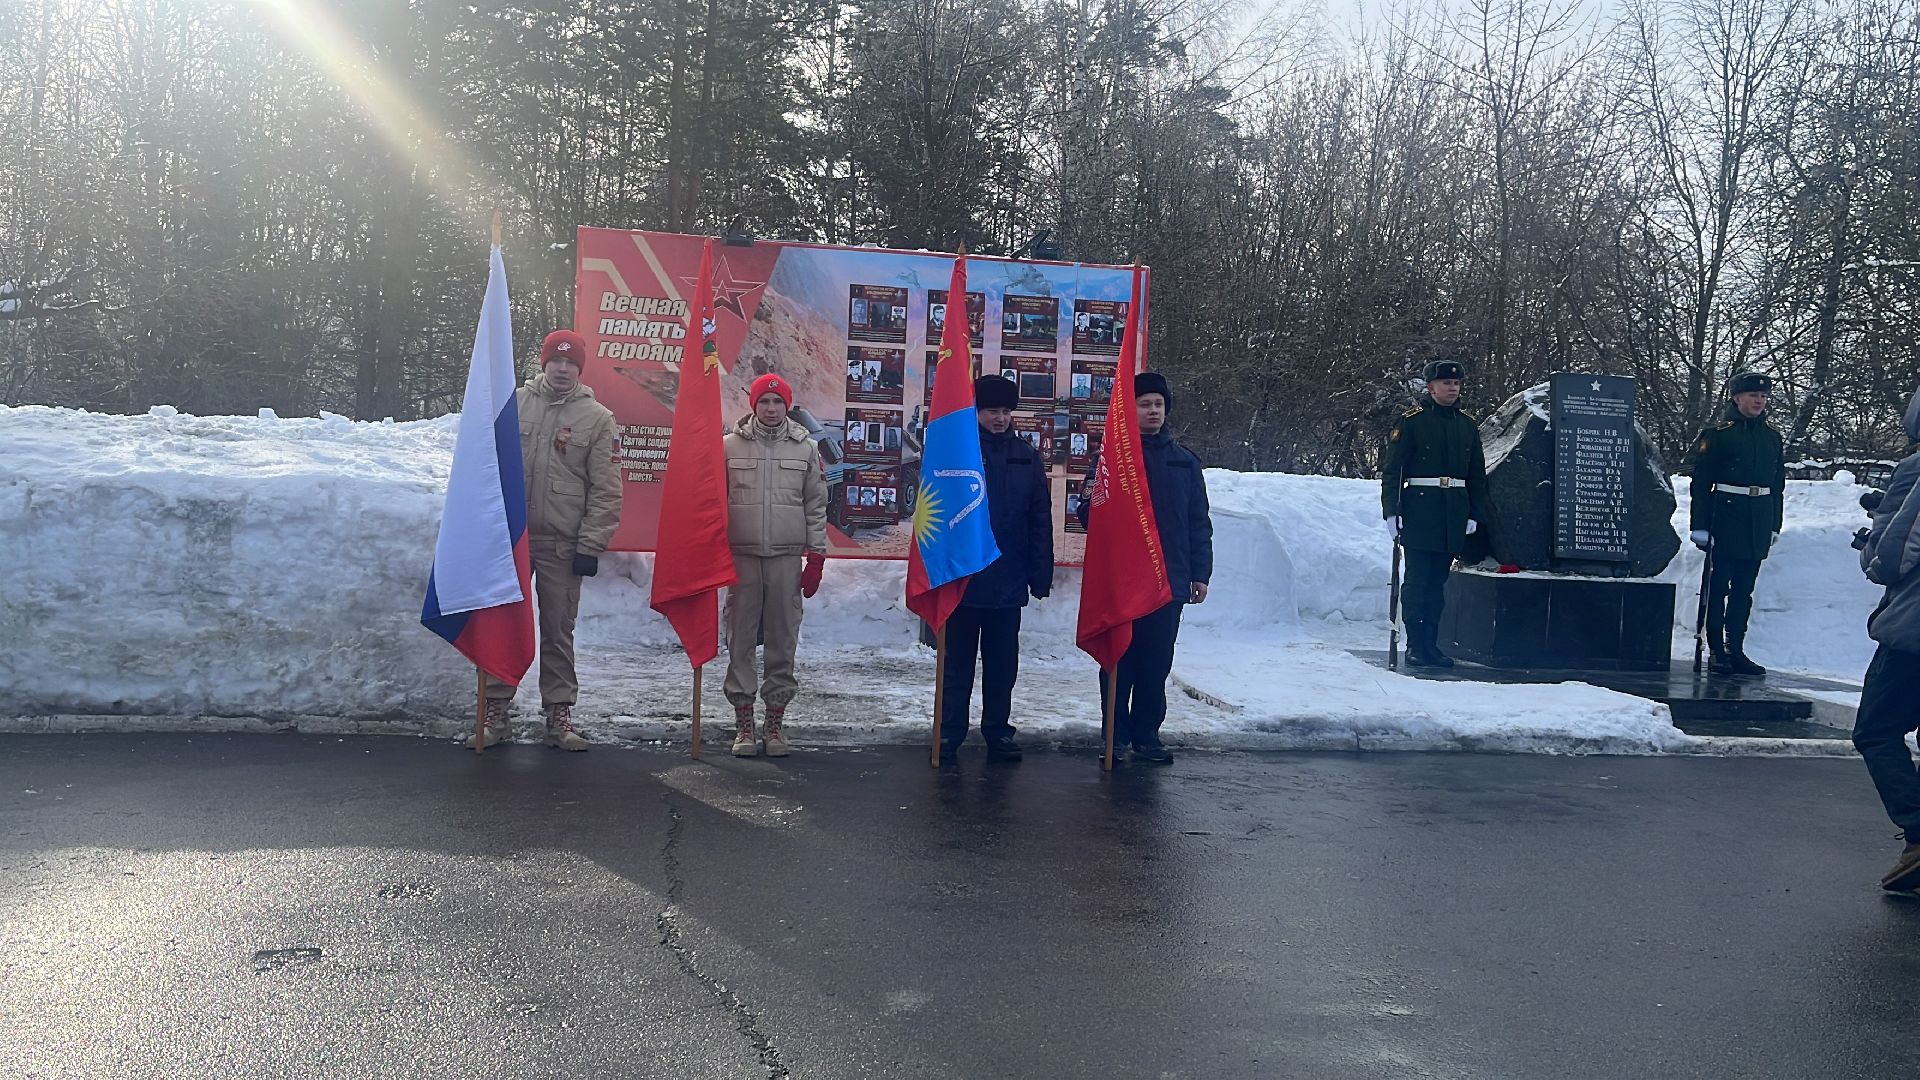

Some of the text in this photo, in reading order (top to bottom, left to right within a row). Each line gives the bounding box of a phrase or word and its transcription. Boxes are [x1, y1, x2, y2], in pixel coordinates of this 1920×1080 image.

[599, 292, 687, 316] Вечная
[599, 318, 686, 339] память
[640, 426, 655, 434] стих
[623, 435, 647, 446] Святой
[628, 449, 666, 459] круговерти
